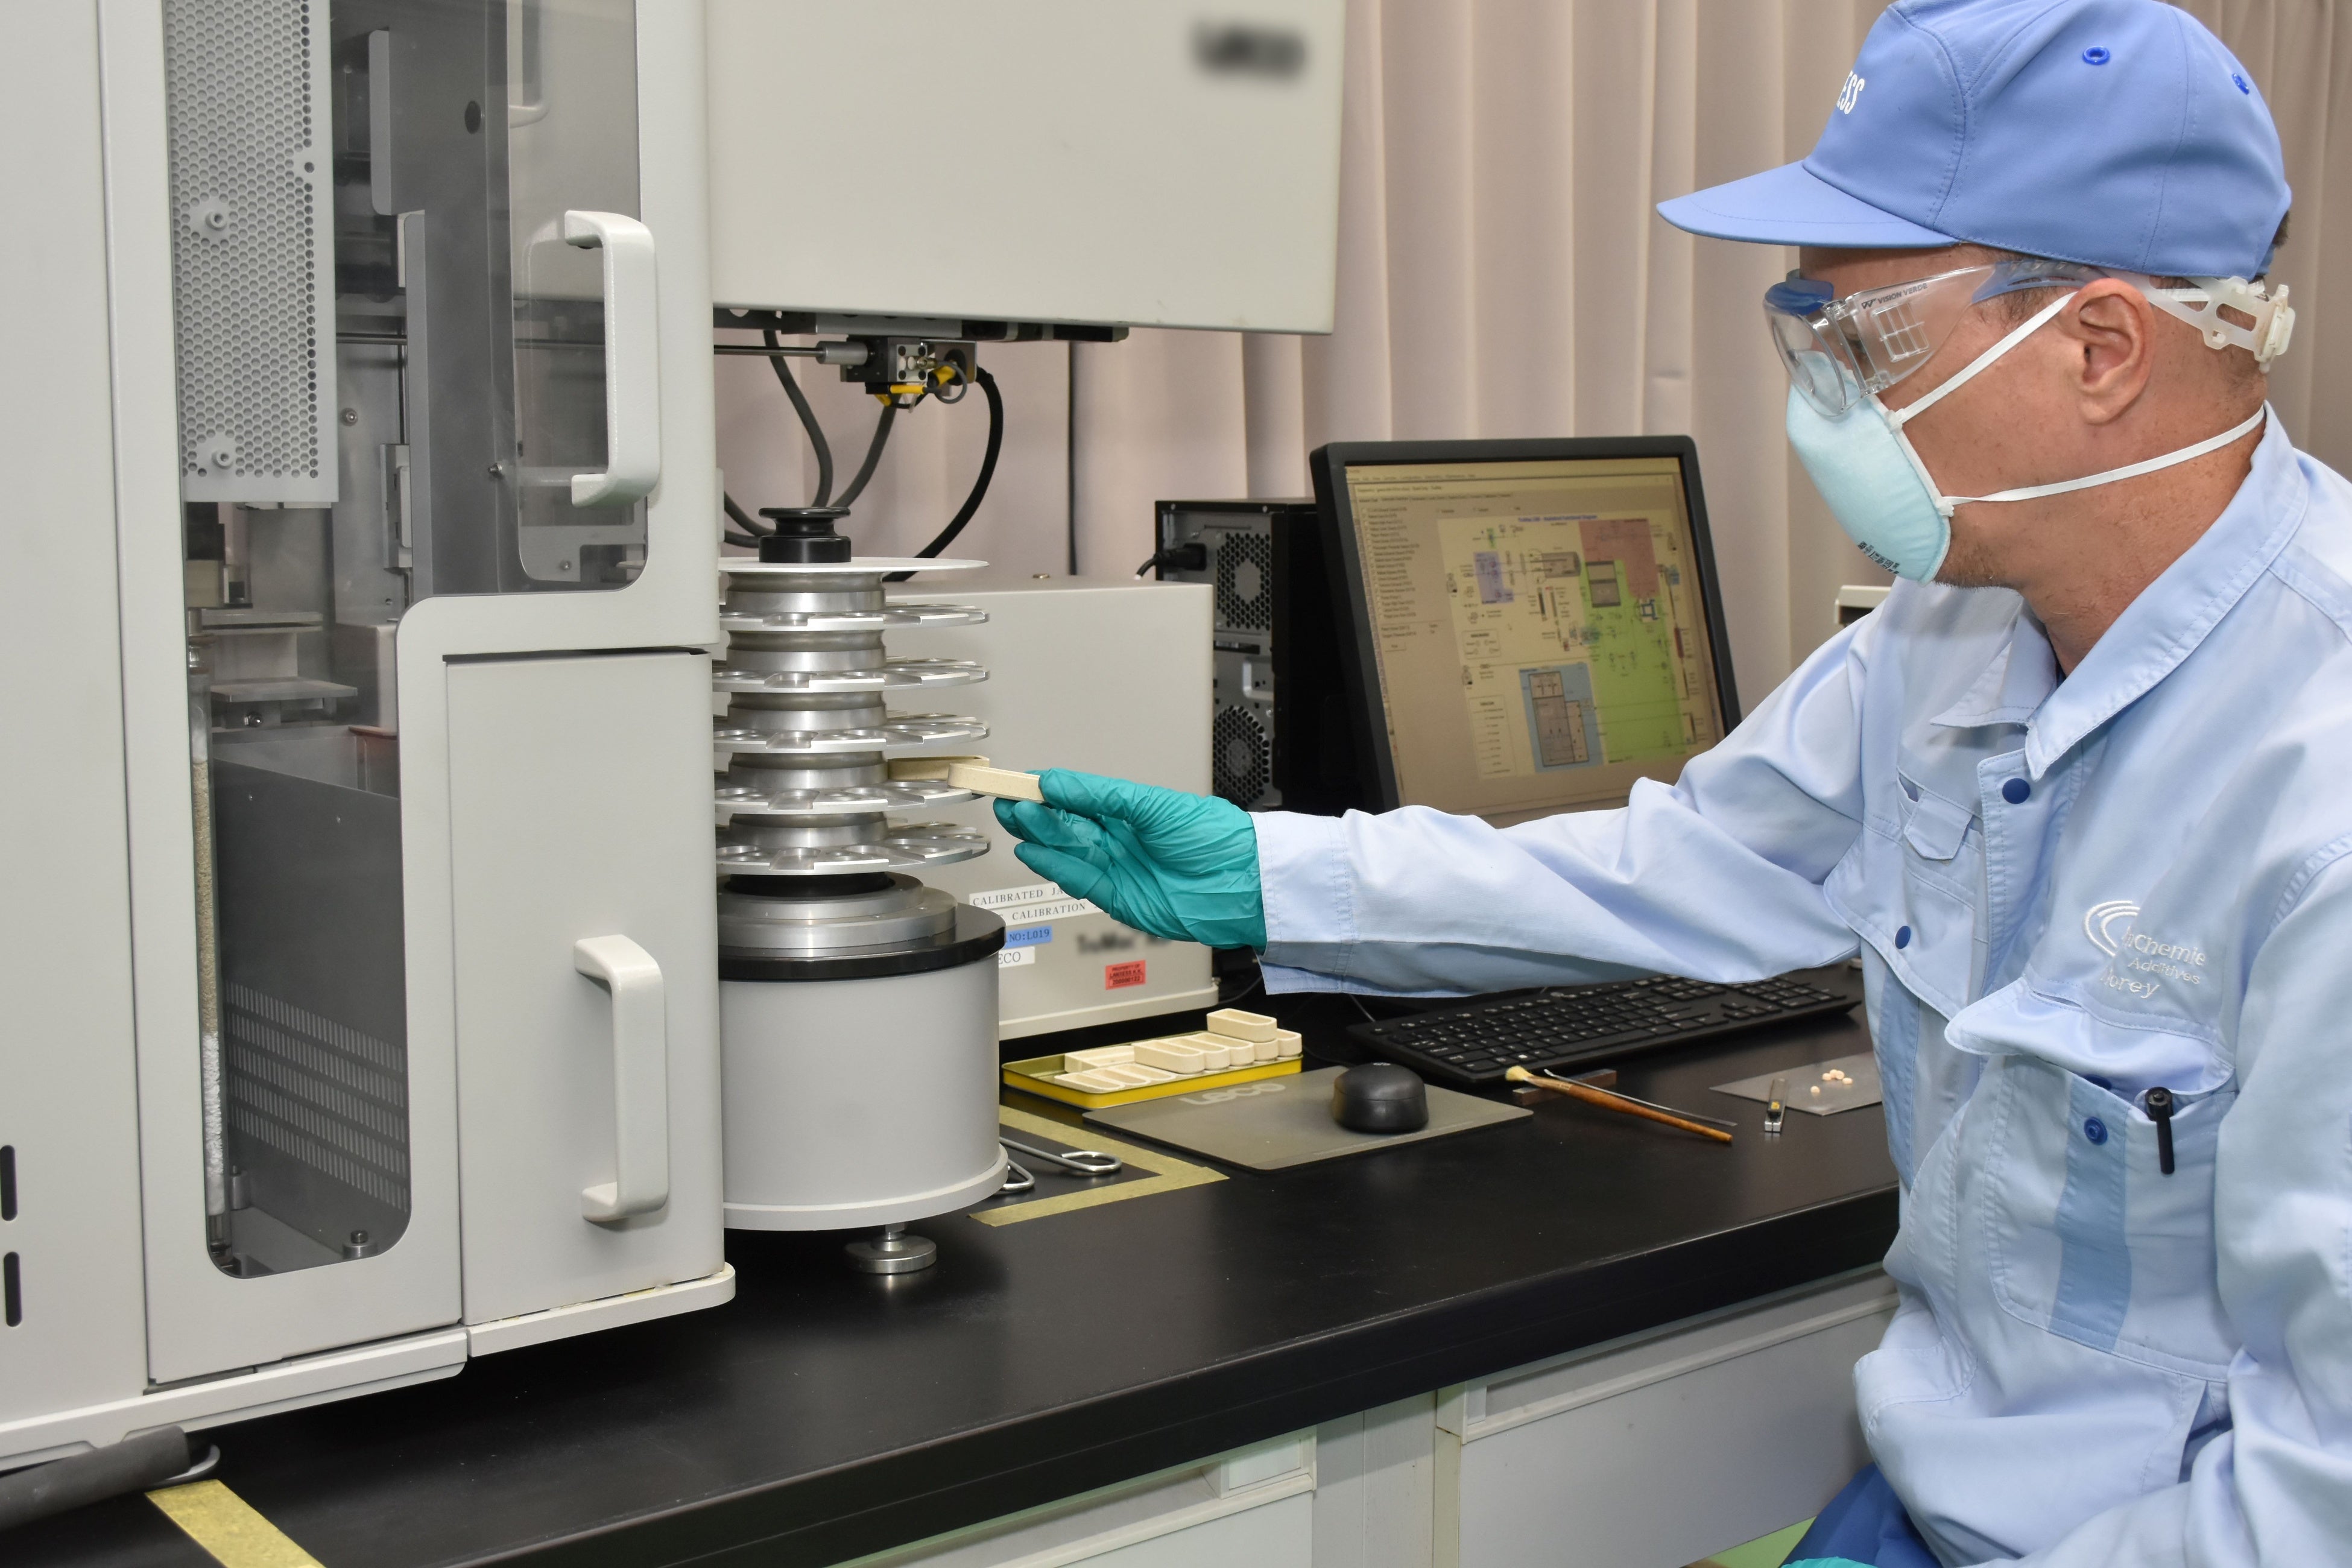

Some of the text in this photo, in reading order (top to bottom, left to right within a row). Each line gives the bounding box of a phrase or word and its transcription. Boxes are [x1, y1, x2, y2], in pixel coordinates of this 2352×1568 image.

[1877, 283, 1928, 304] VISION VERDE
[973, 890, 1043, 906] CALIBRATED
[1013, 902, 1086, 920] CALIBRATION
[2128, 958, 2201, 985] Additives
